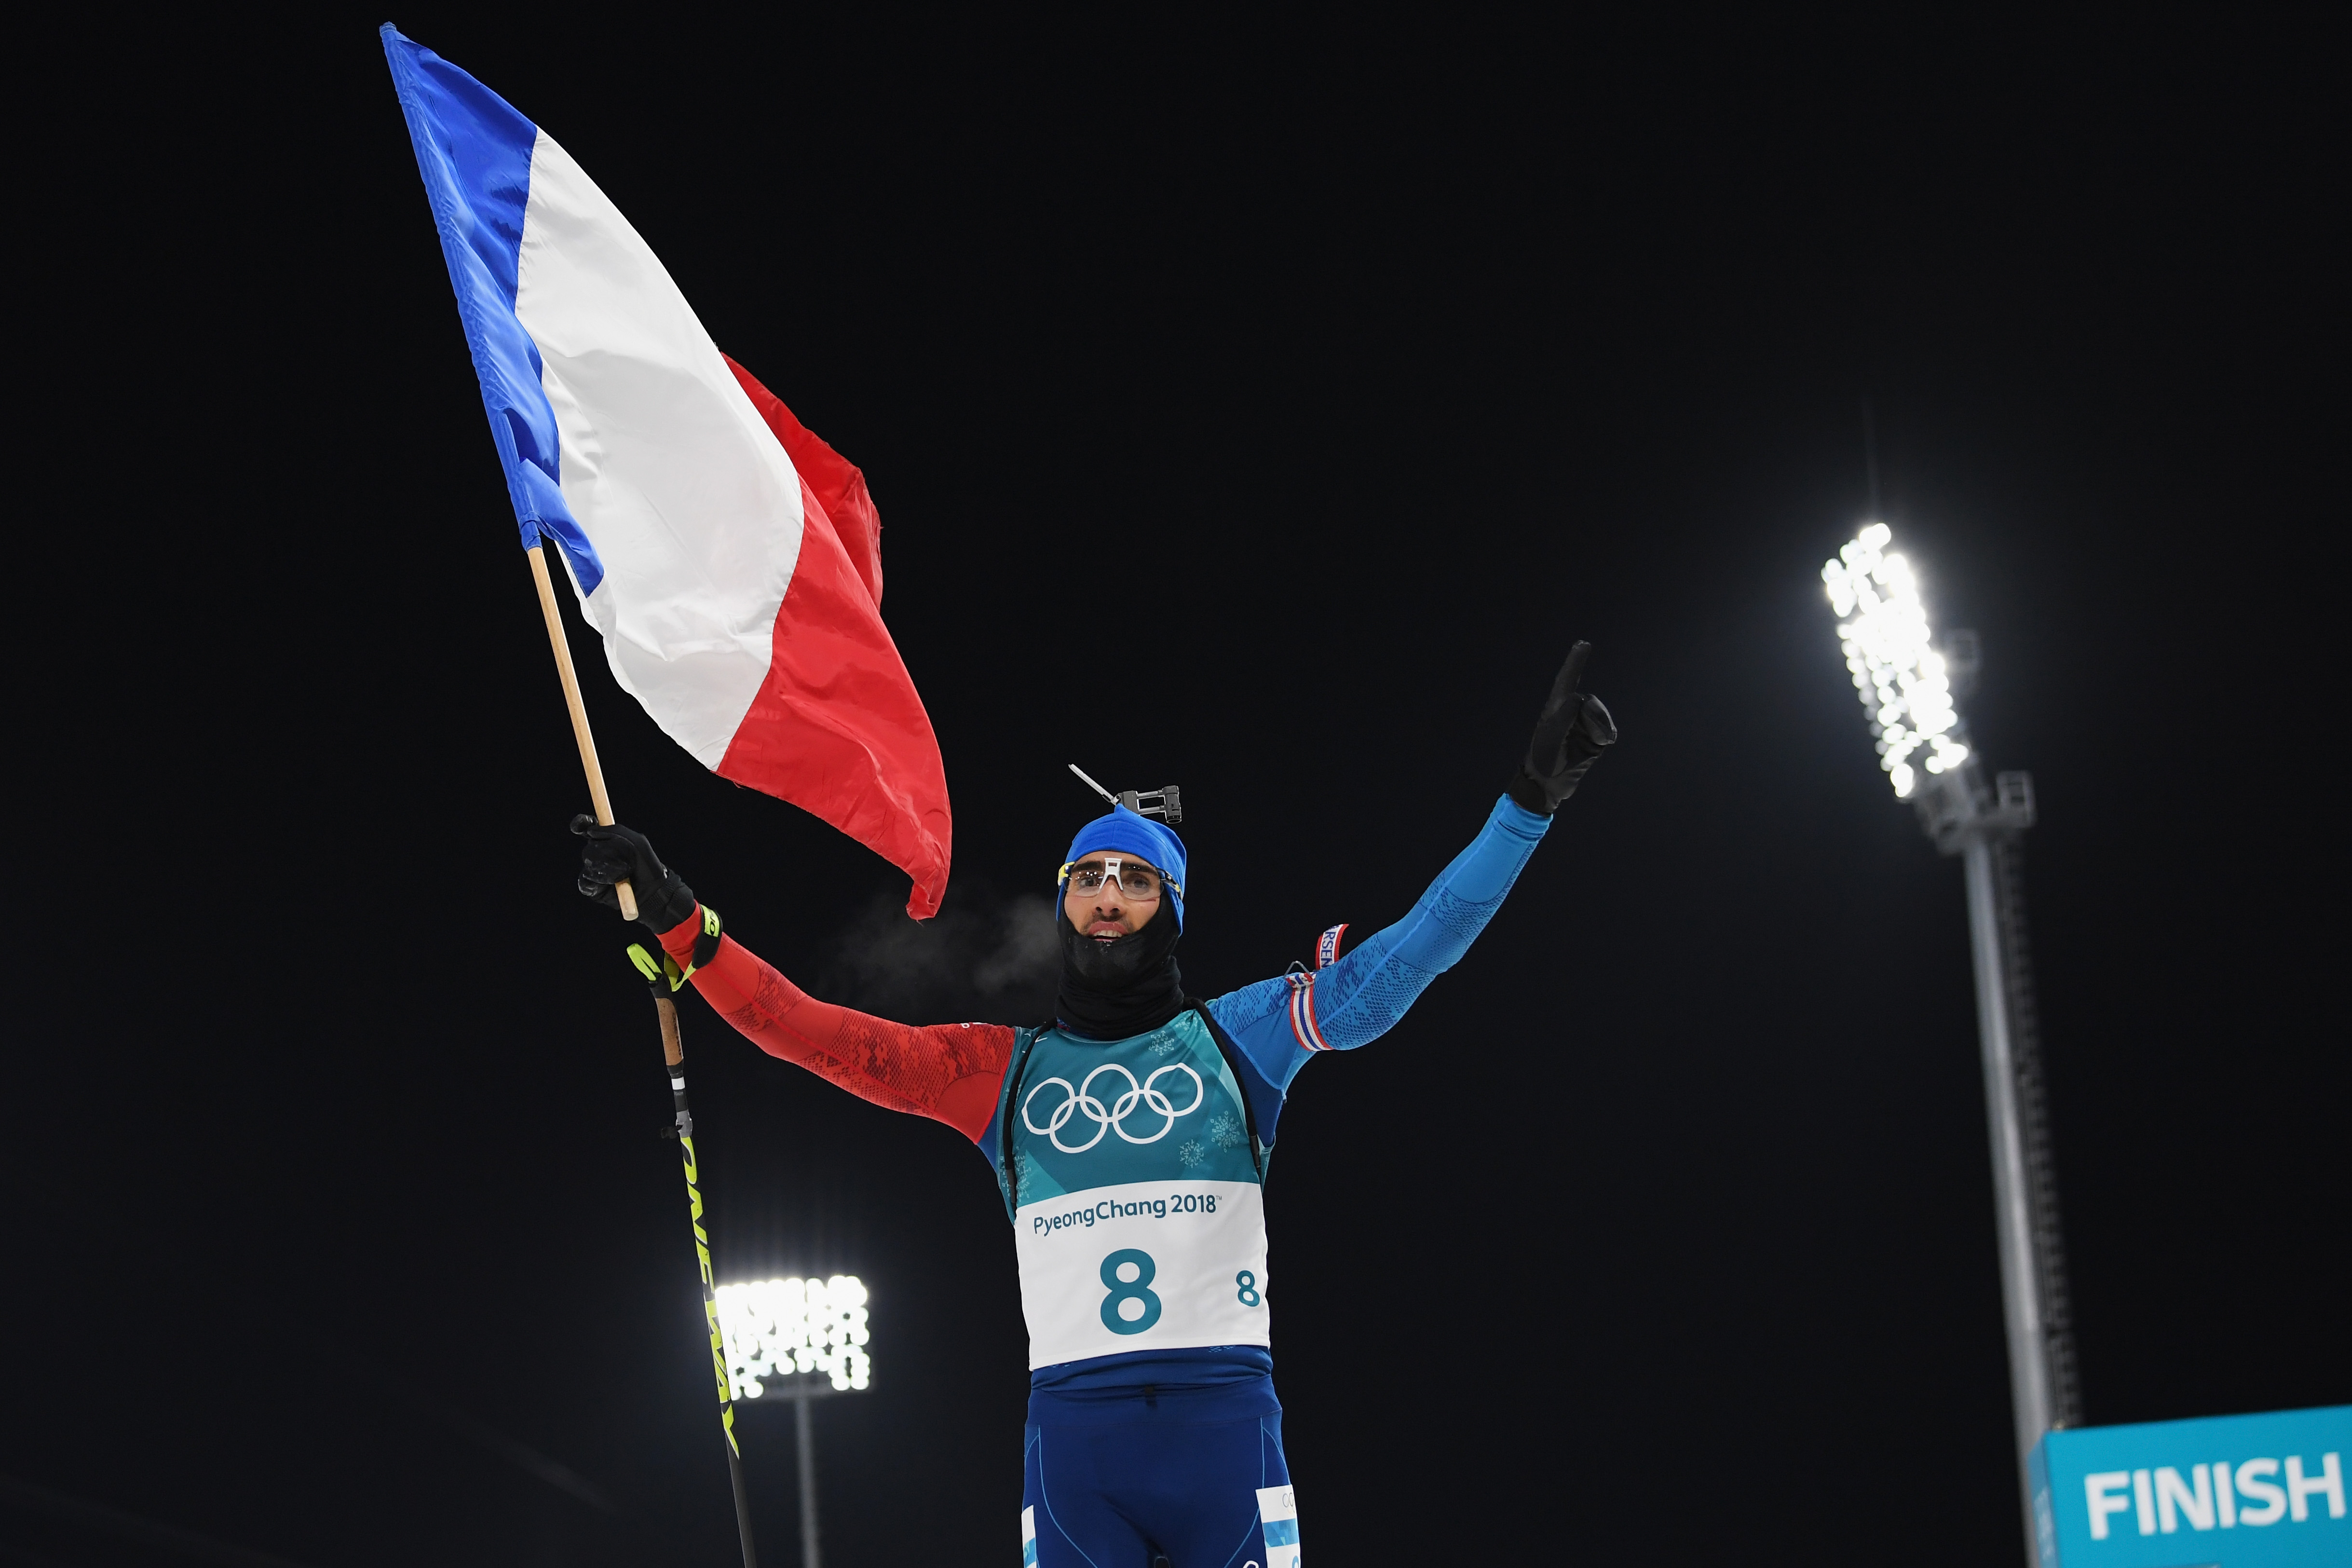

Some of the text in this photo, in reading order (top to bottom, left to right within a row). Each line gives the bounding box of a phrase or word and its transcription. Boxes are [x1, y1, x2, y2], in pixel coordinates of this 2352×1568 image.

[1321, 925, 1339, 968] RSEN
[1034, 1200, 1166, 1237] PyeongChang
[1170, 1194, 1216, 1213] 2018
[1100, 1248, 1162, 1335] 8
[1236, 1270, 1260, 1307] 8
[2083, 1451, 2347, 1541] FINISH
